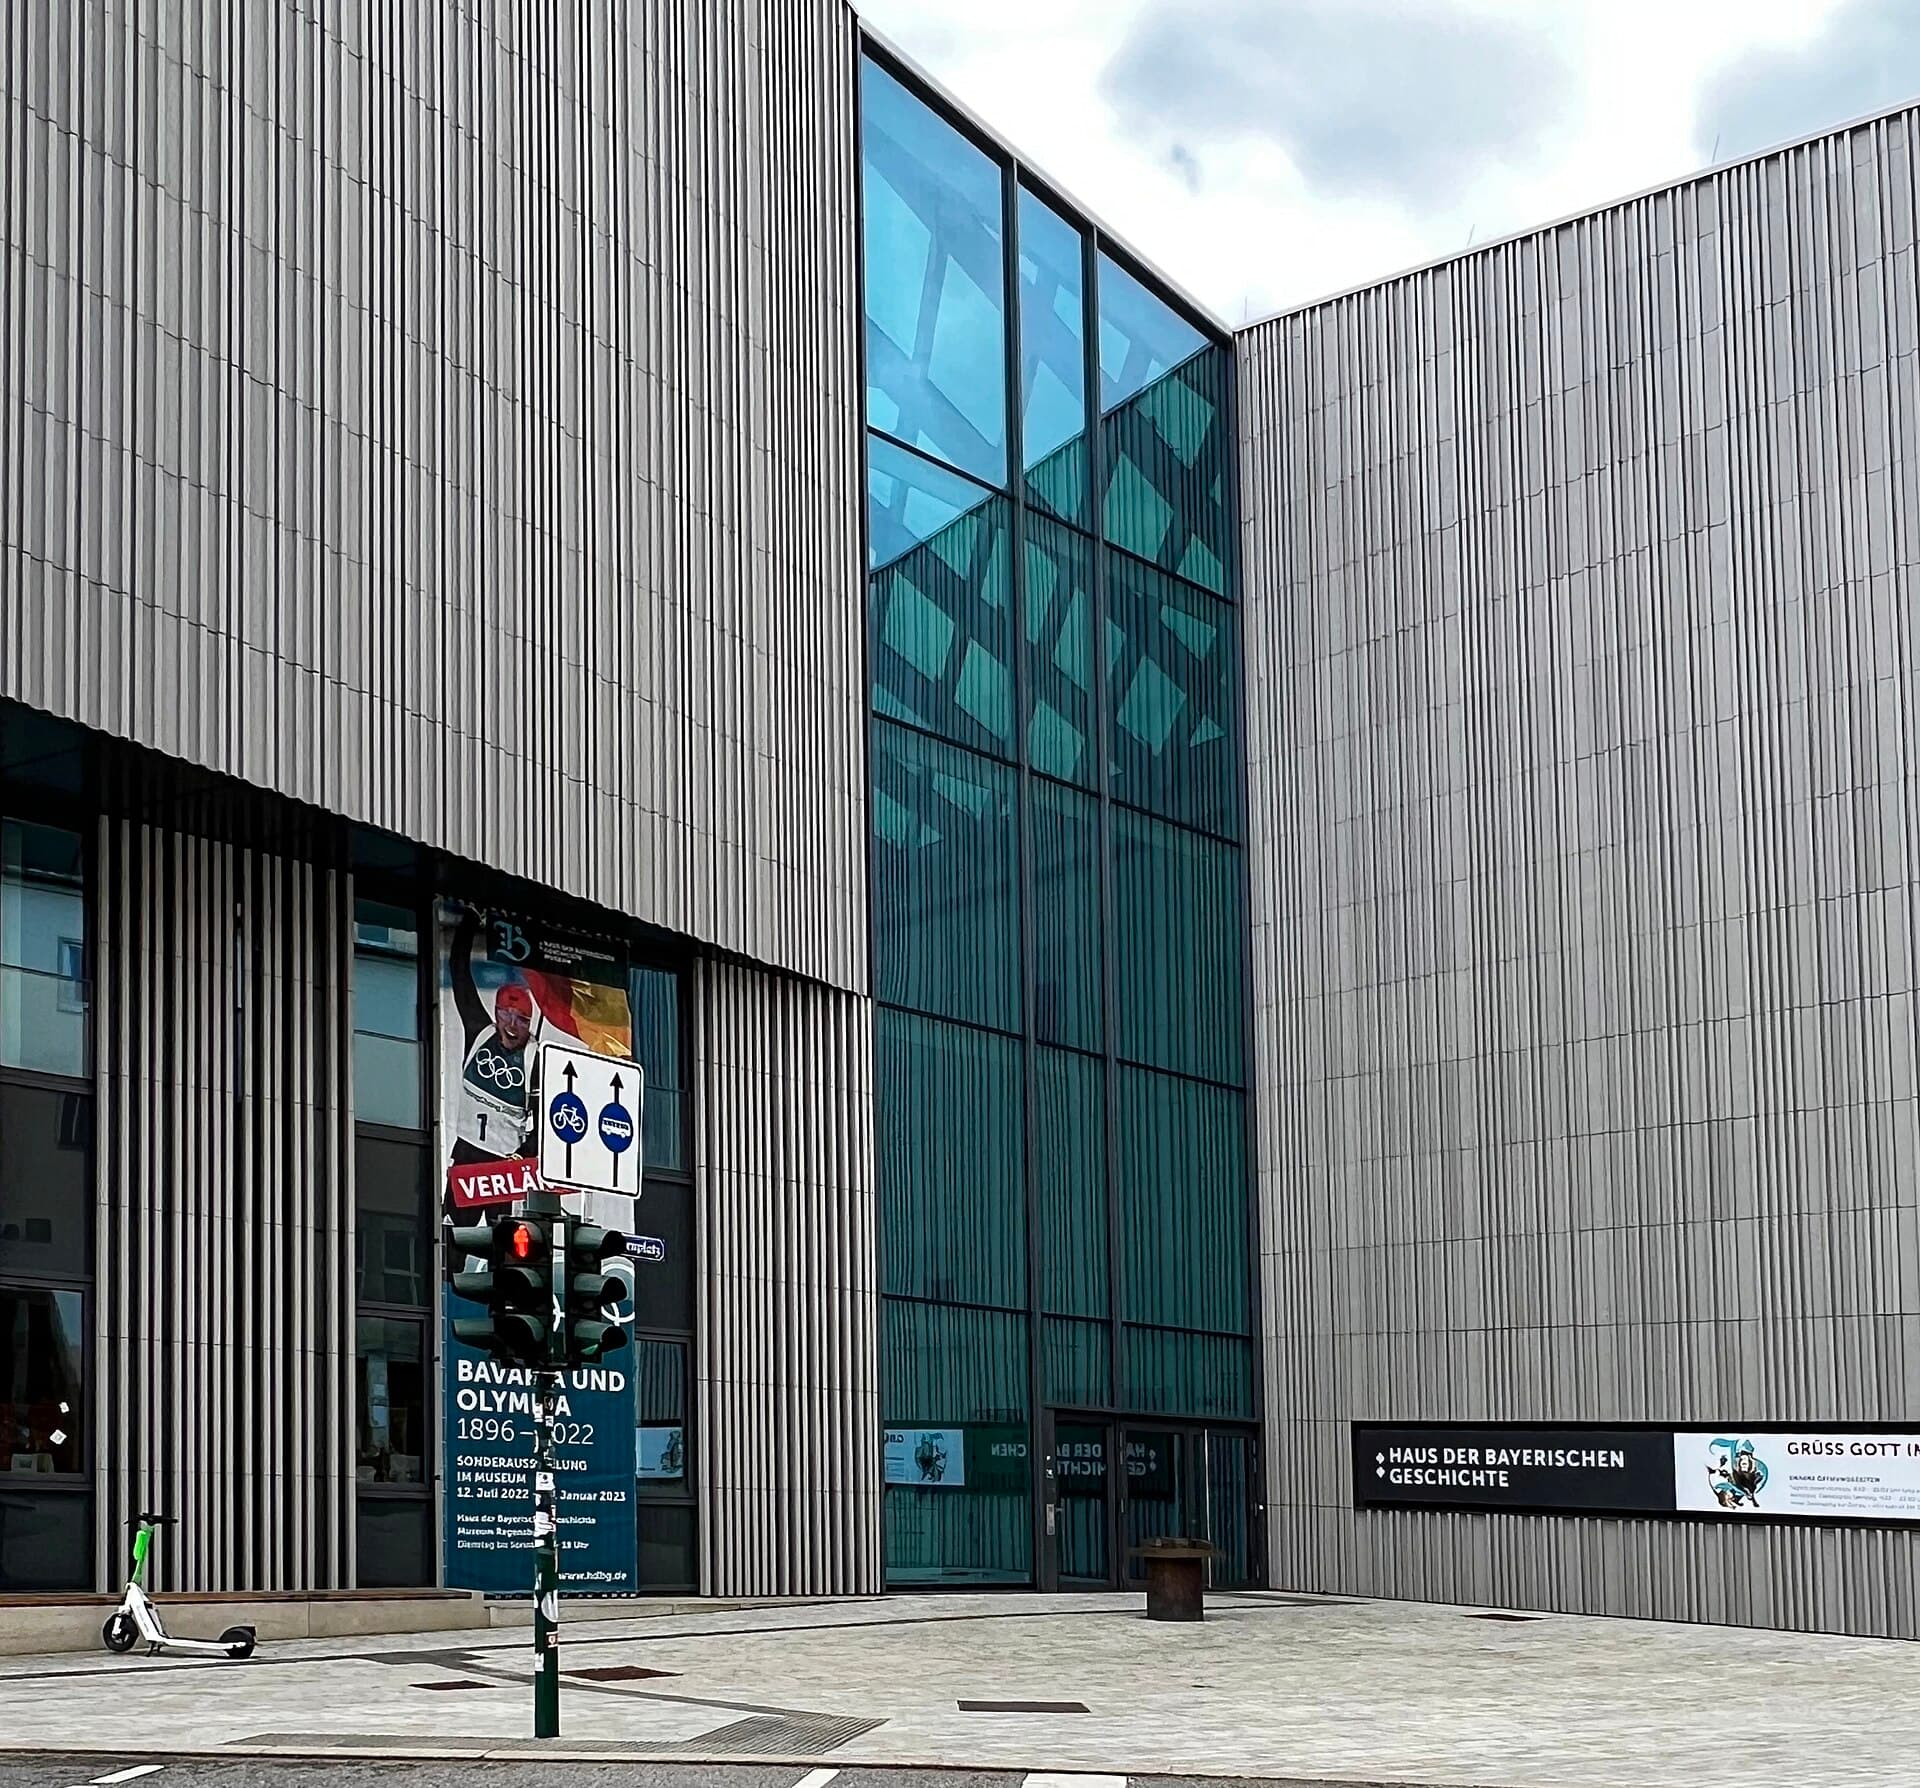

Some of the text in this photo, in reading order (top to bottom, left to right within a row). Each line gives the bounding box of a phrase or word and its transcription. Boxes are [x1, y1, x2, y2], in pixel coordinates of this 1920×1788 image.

[457, 1359, 626, 1392] BAVAA UND
[456, 1388, 572, 1416] OLYMA
[457, 1418, 515, 1442] 1896
[549, 1422, 595, 1445] 022
[1389, 1447, 1625, 1468] HAUS DER BAYERISCHEN
[1787, 1440, 1845, 1456] GRÜSS
[1850, 1442, 1901, 1457] GOTT
[456, 1471, 527, 1485] IM MUSEUM
[1389, 1468, 1510, 1488] GESCHICHTE
[456, 1487, 474, 1499] 12.
[476, 1488, 498, 1499] Juli
[500, 1488, 530, 1500] 2022
[560, 1489, 598, 1502] Januar
